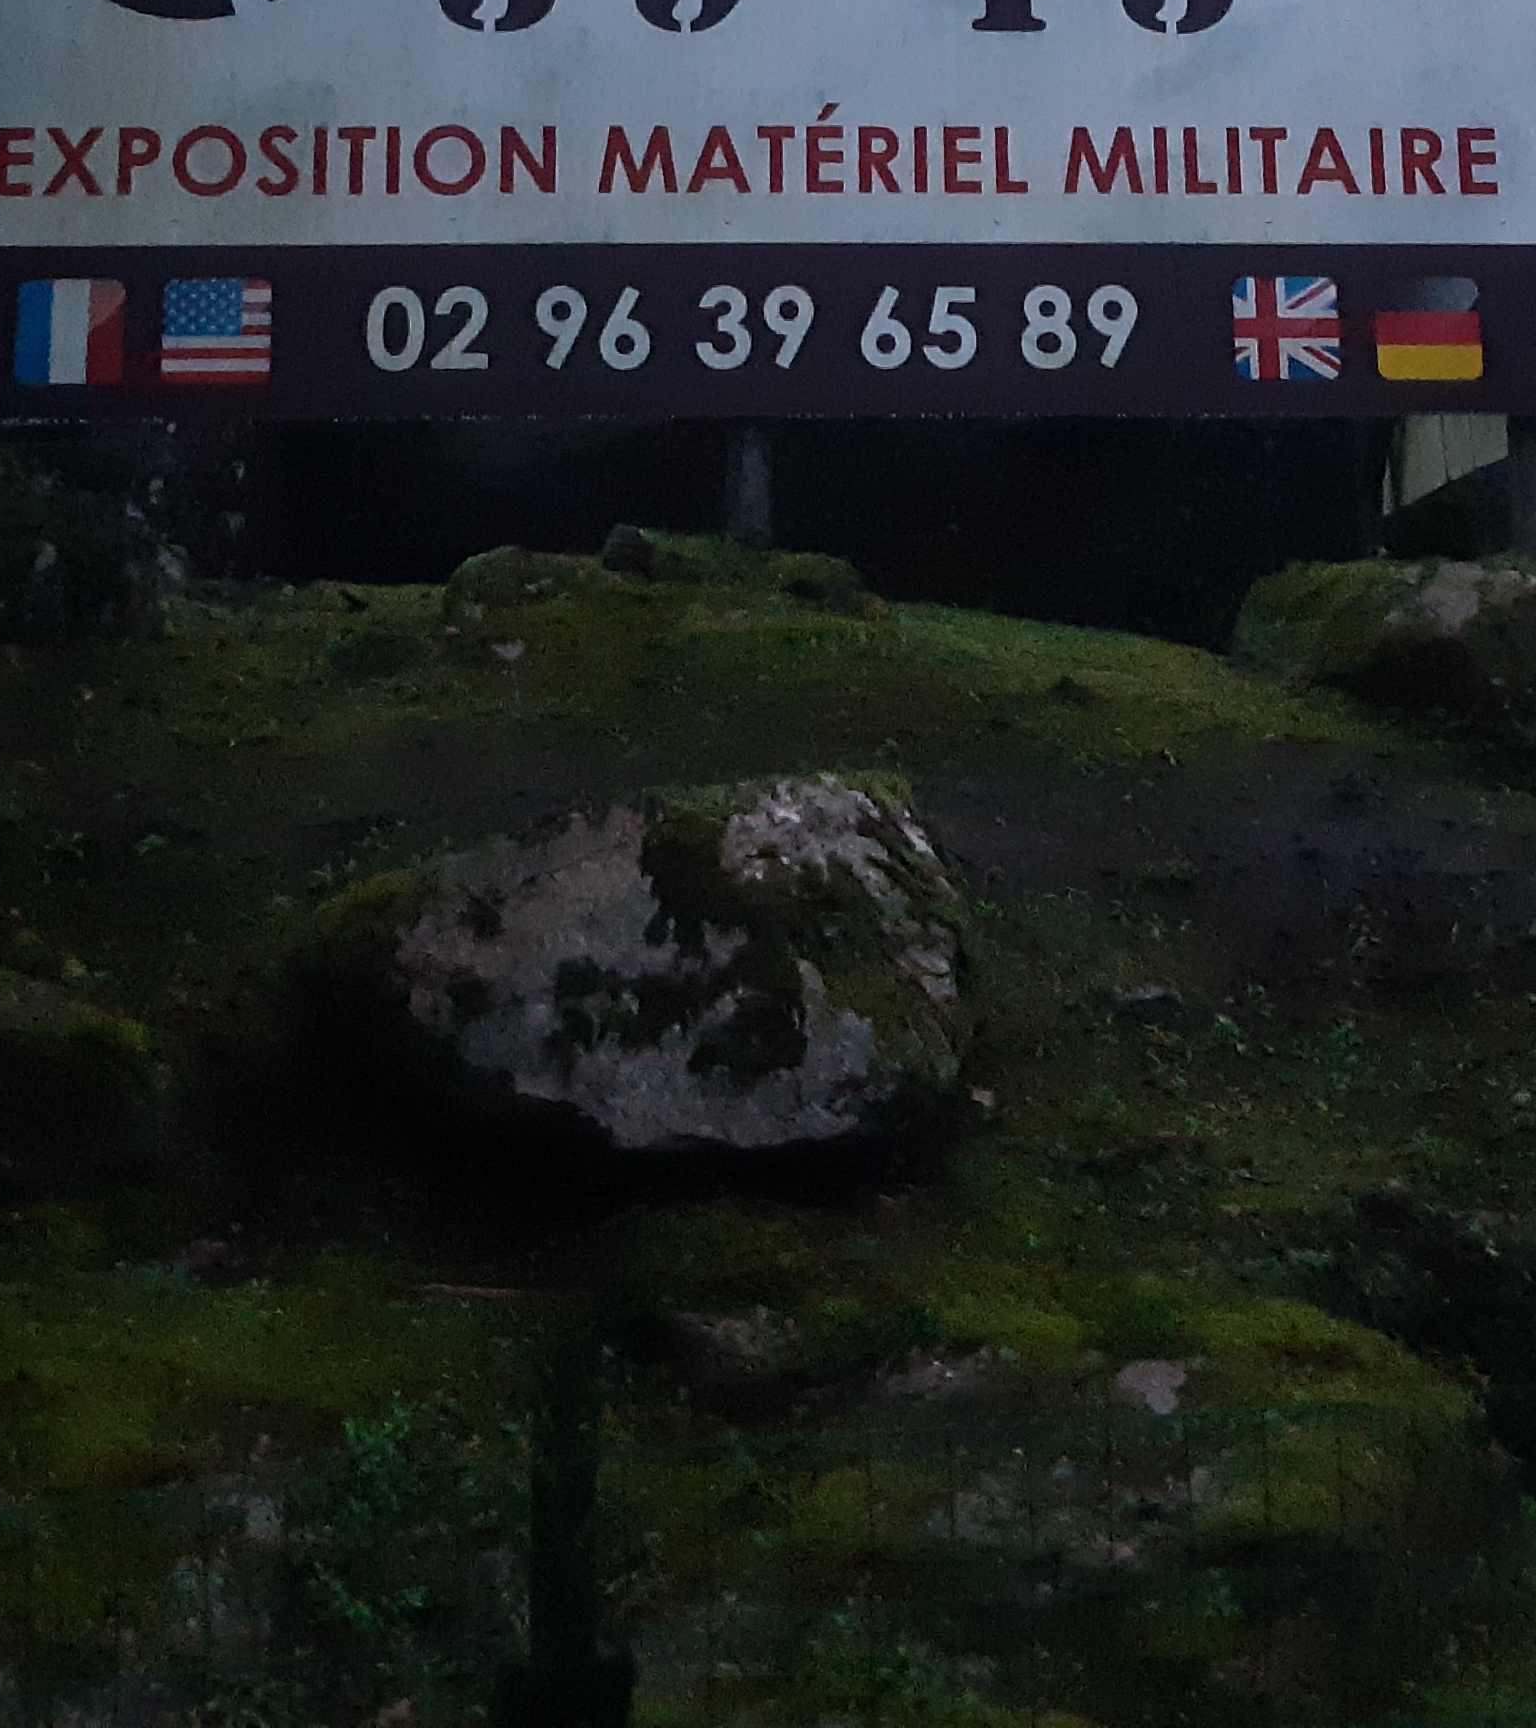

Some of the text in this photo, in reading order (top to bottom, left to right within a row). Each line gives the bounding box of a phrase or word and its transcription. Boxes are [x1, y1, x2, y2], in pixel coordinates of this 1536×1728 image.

[598, 103, 1028, 195] MATÉRIEL
[1065, 127, 1500, 196] MILITAIRE
[366, 284, 1140, 372] 02 96 39 65 89
